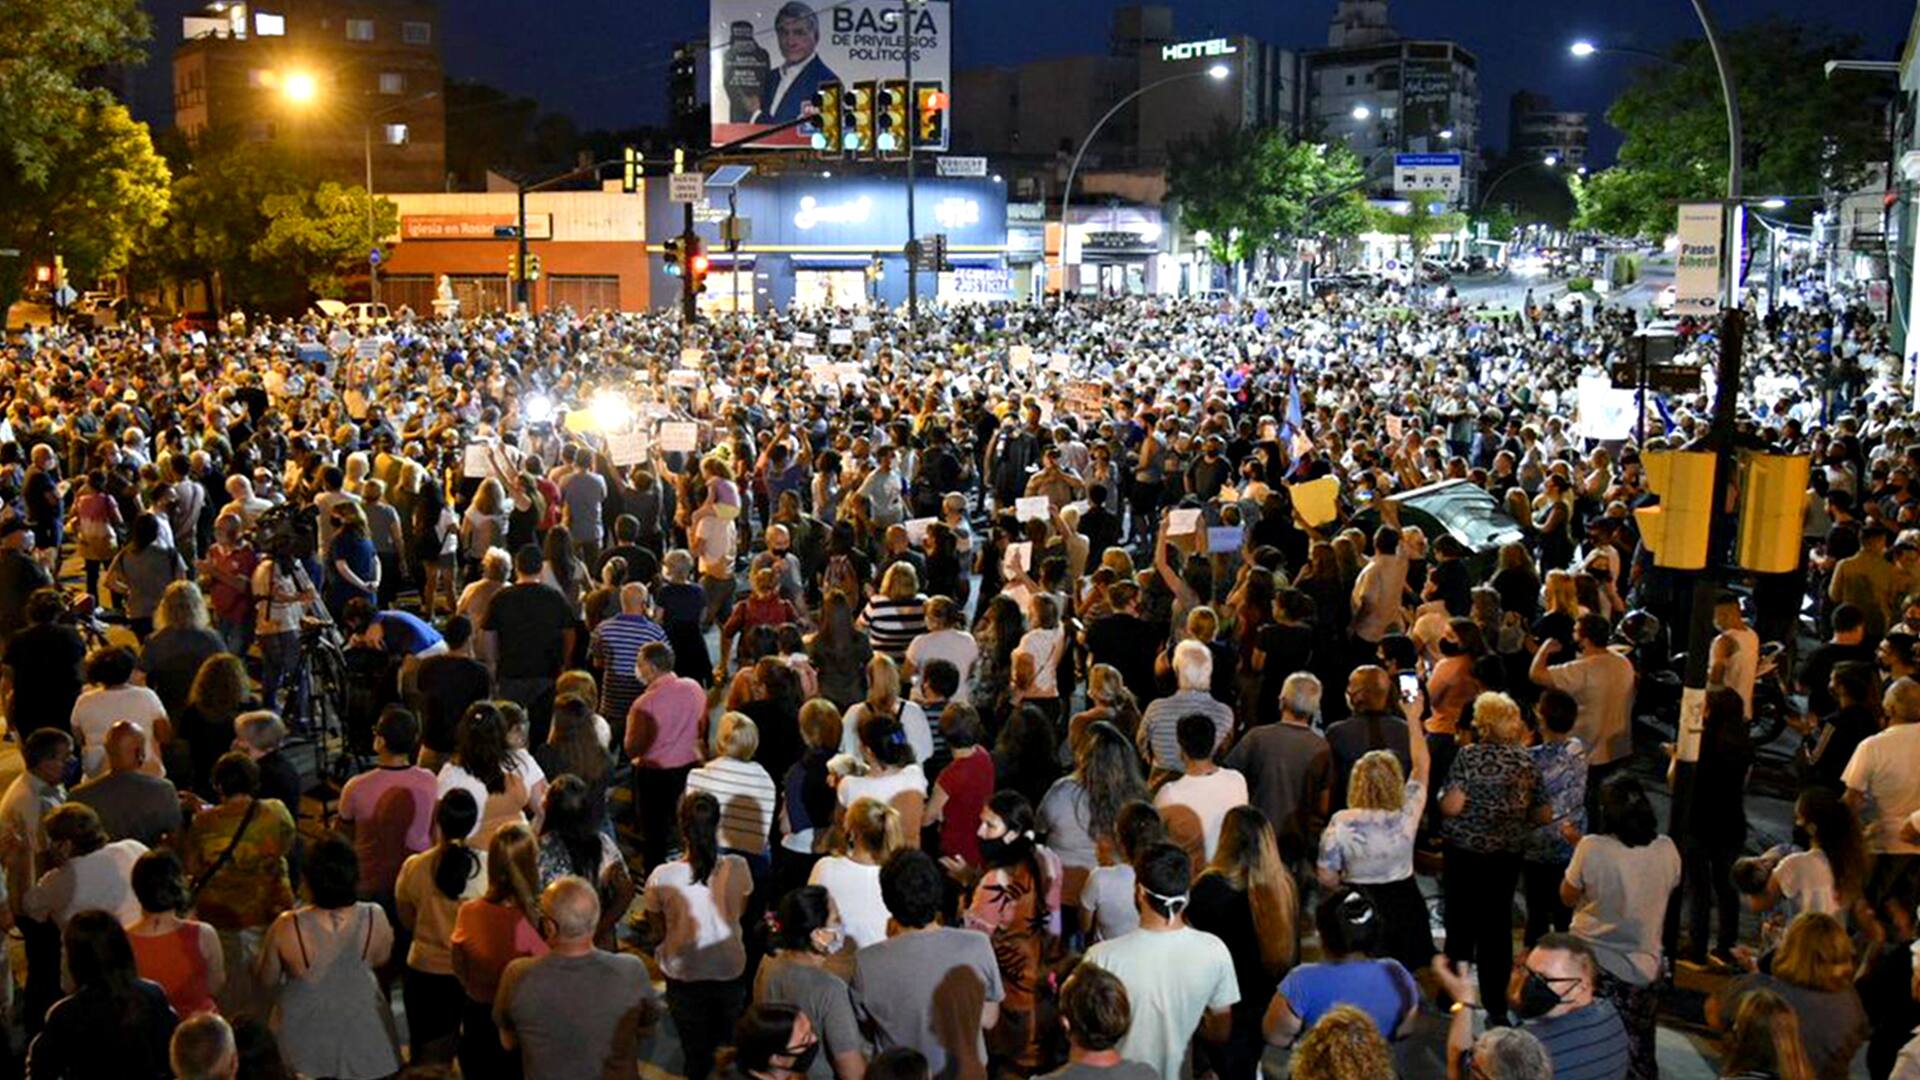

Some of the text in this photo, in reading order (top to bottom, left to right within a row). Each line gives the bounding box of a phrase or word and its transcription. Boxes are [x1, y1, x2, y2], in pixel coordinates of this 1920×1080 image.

[833, 7, 937, 35] BASTA
[832, 34, 851, 46] DE
[849, 48, 920, 62] POLÍTICOS
[1162, 38, 1238, 61] HOTEL
[460, 222, 496, 235] Rosari
[1682, 244, 1716, 255] Paseo
